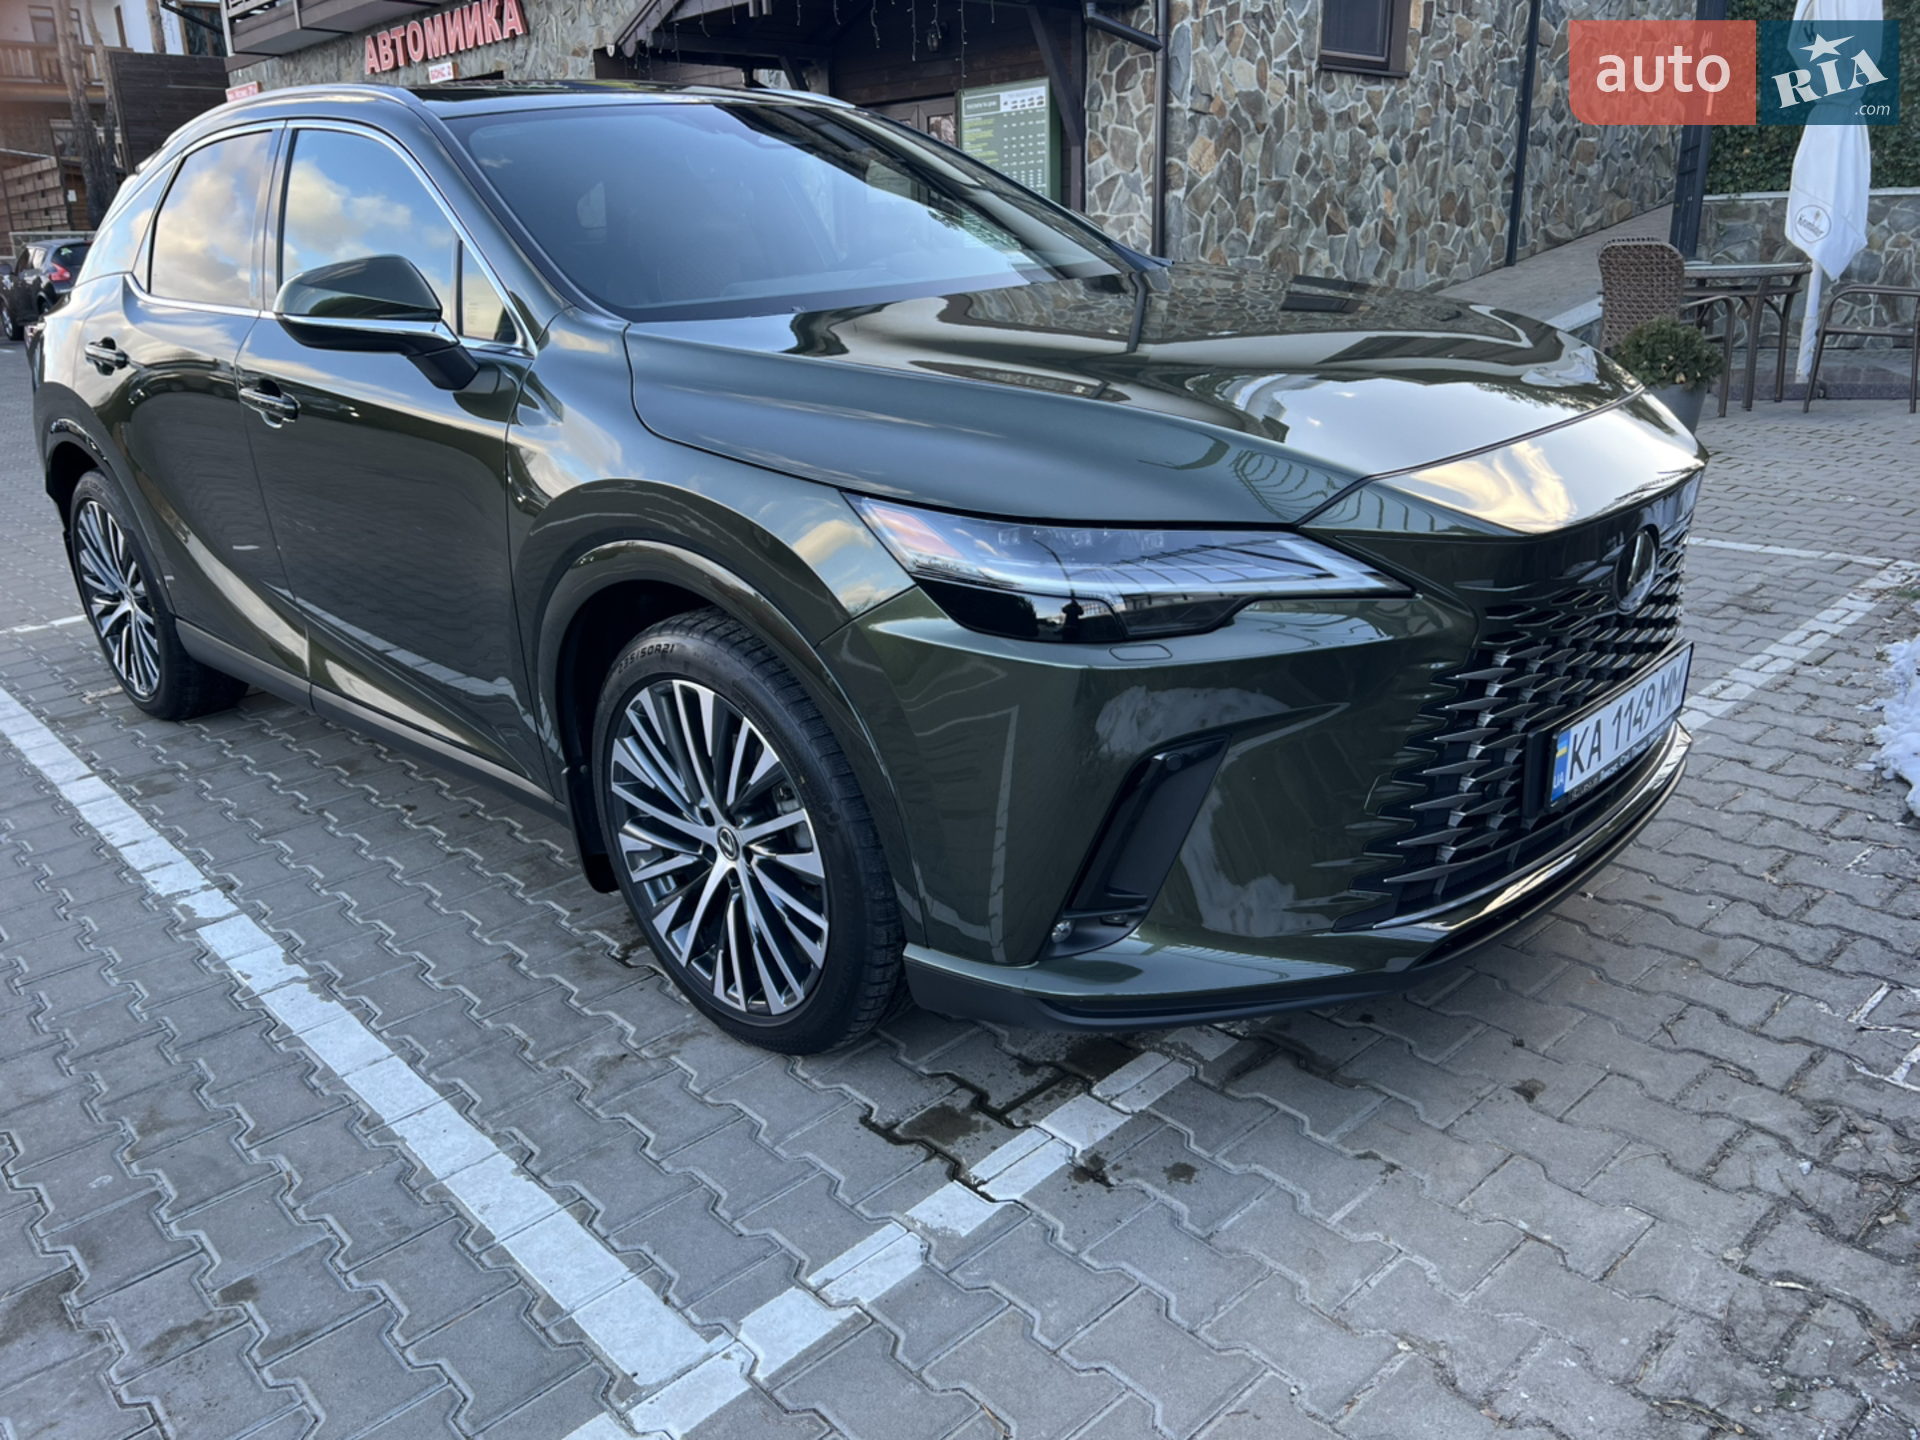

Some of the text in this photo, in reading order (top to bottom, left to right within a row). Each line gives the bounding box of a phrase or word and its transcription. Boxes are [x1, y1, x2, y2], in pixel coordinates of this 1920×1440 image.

[1569, 718, 1602, 781] KA
[1611, 683, 1656, 751] 1149
[1553, 771, 1565, 789] UA
